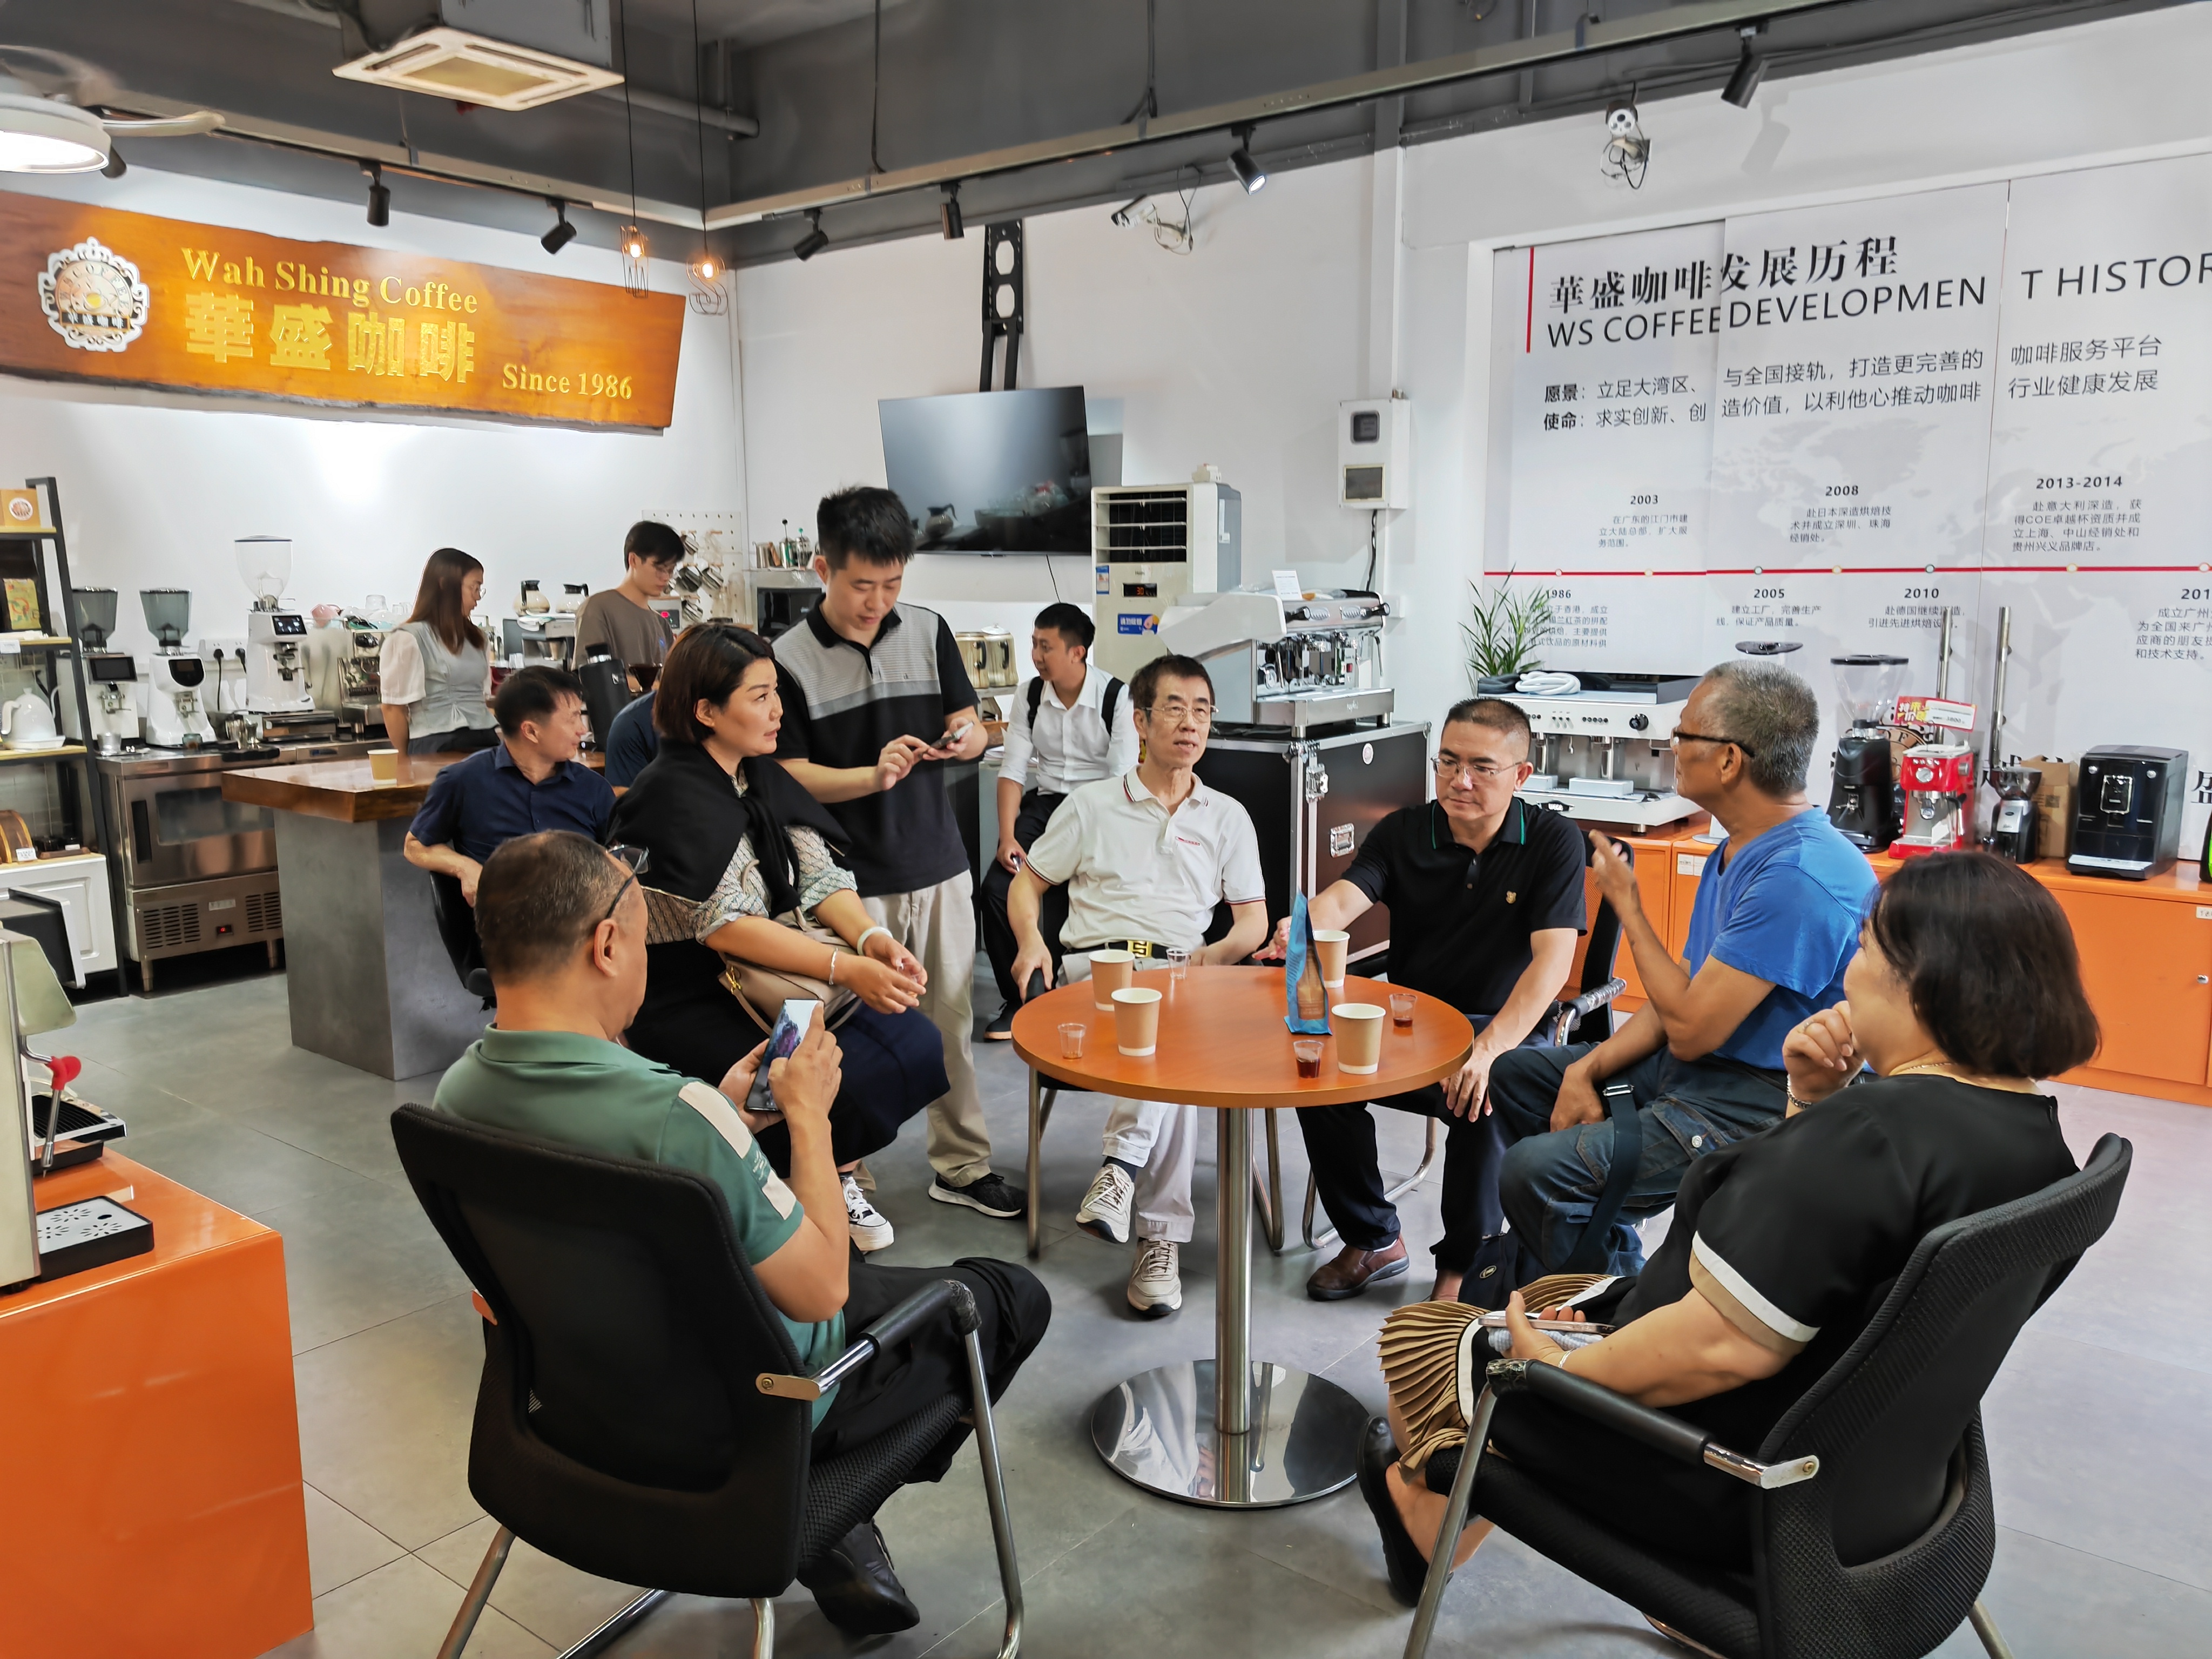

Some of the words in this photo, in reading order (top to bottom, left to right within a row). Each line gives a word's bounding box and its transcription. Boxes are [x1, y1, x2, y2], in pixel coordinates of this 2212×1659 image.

[181, 247, 265, 287] Wah
[275, 261, 370, 308] Shing
[380, 276, 478, 313] Coffee
[1549, 235, 1897, 314] 華盛咖啡发展历程
[1547, 319, 1593, 348] WS
[1604, 306, 1721, 342] COFFEE
[2058, 253, 2212, 296] HISTOR
[185, 292, 475, 383] 華盛咖啡
[503, 363, 570, 394] Since
[578, 372, 632, 400] 1986
[2036, 476, 2122, 489] 2013-2014
[1825, 484, 1859, 496] 2008
[1630, 495, 1658, 505] 2003
[1546, 589, 1572, 599] 1986
[1754, 589, 1785, 599] 2005
[1904, 588, 1939, 598] 2010
[2158, 607, 2212, 619] 成立广州
